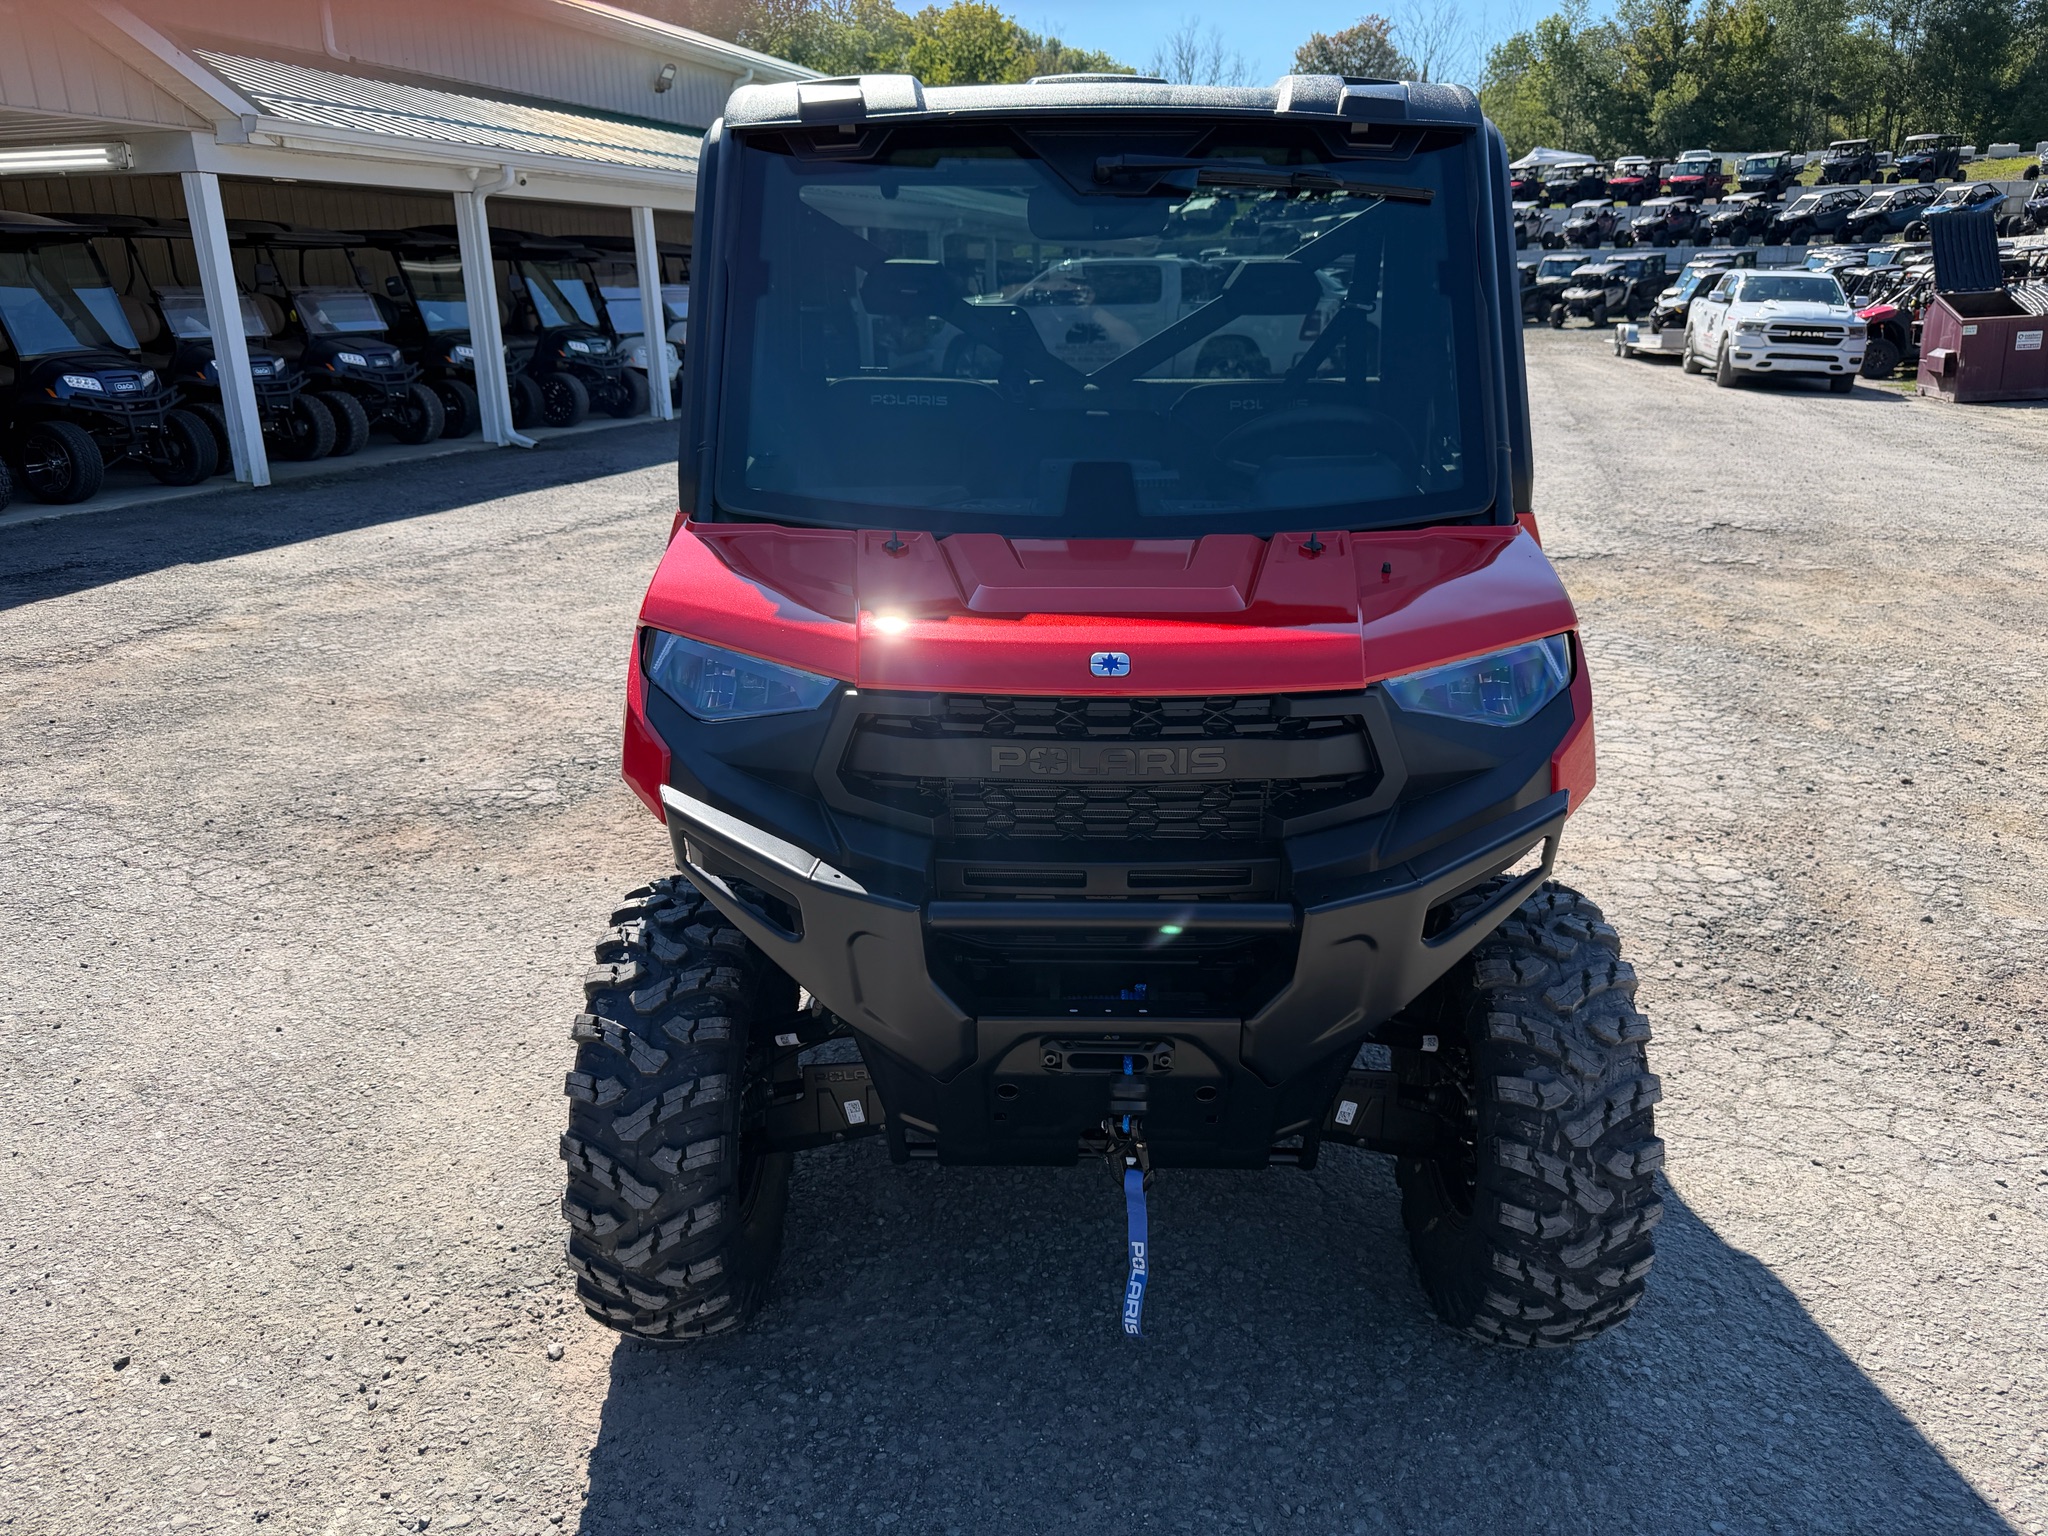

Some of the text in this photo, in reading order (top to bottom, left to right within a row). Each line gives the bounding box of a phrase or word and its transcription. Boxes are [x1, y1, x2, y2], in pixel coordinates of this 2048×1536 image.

[1790, 330, 1824, 338] RAM
[870, 393, 949, 406] POLARIS
[1229, 398, 1310, 411] POLIS
[990, 745, 1228, 776] POLARIS
[814, 1068, 872, 1083] POLA
[1124, 1241, 1146, 1335] POLARIS
